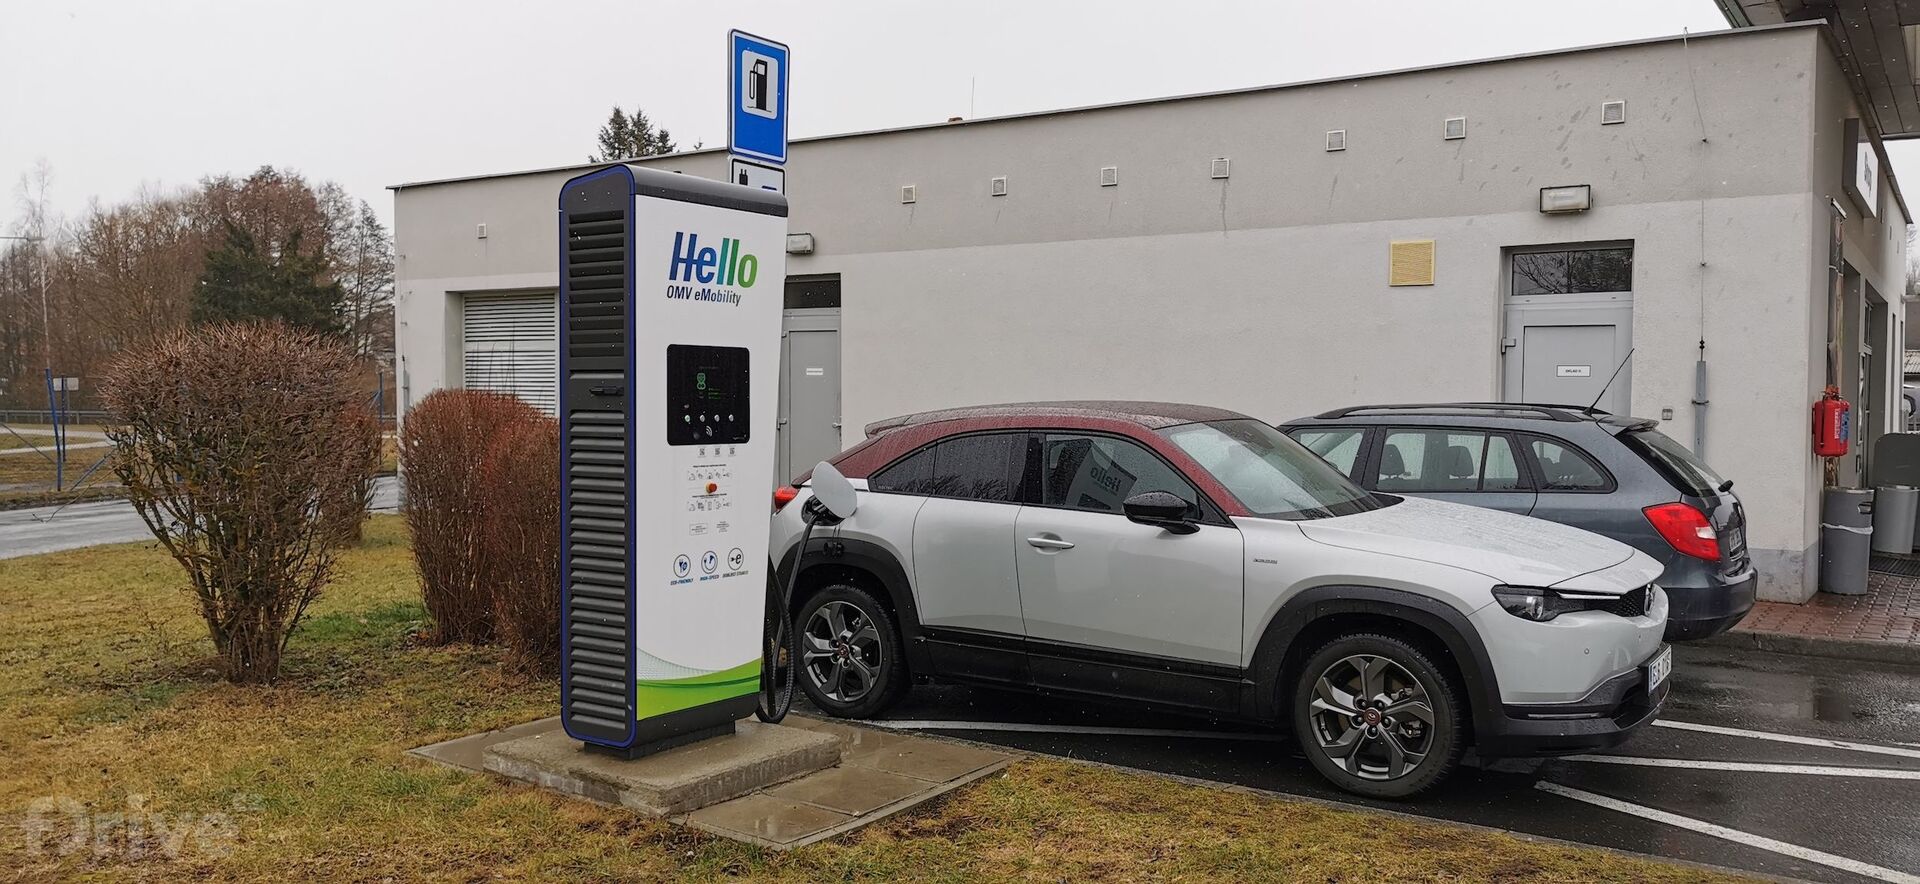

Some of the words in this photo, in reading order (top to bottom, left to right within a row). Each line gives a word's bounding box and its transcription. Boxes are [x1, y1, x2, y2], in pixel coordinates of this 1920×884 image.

[668, 231, 758, 288] Hello
[666, 285, 693, 300] OMV
[694, 288, 742, 307] eMobility
